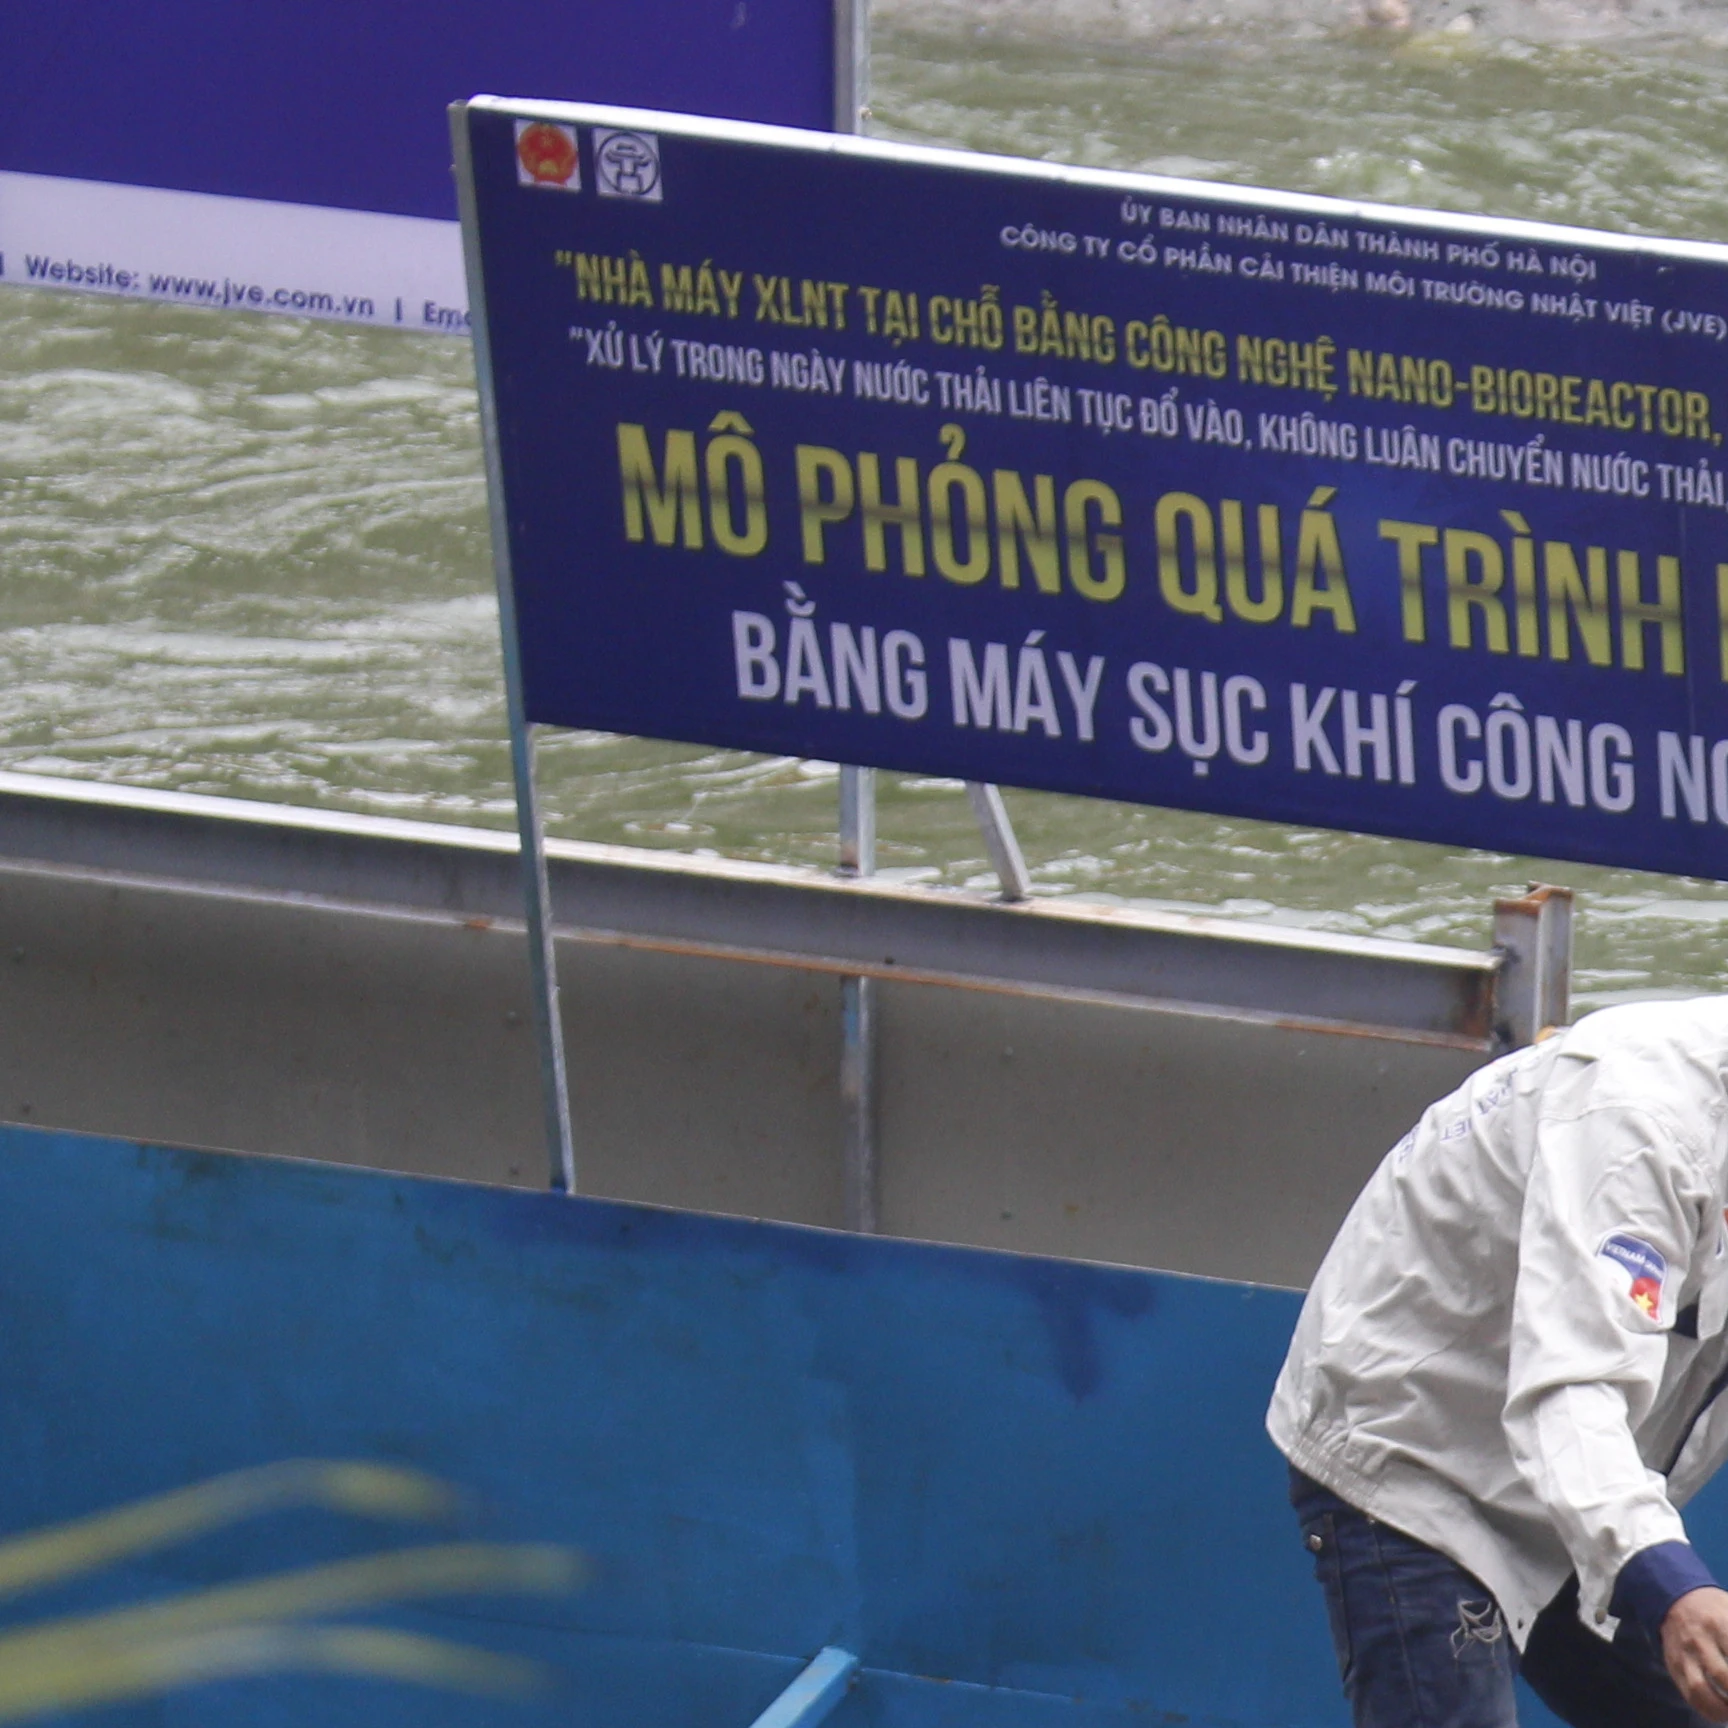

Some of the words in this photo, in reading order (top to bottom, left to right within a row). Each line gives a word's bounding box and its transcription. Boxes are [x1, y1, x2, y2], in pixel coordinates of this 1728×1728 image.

[25, 253, 140, 290] Website:
[149, 270, 375, 318] www.jve.com.vn
[1001, 222, 1078, 255] CÔNG
[1083, 235, 1111, 258] TY
[1163, 241, 1233, 275] PHẦN
[1239, 252, 1284, 281] CẢI
[1290, 262, 1359, 295] THIỆN
[1365, 271, 1415, 298] MÔI
[1531, 293, 1598, 324] NHẬT
[1604, 300, 1654, 329] VIỆT
[1661, 310, 1728, 340] (JVE)
[1159, 206, 1211, 232] BAN
[1217, 213, 1289, 243] NHÂN
[1295, 221, 1350, 249] DÂN
[1355, 231, 1440, 262] THÀNH
[1446, 241, 1500, 269] PHỐ
[1506, 249, 1543, 275] HÀ
[1549, 255, 1597, 285] NỘI
[630, 329, 665, 374] LÝ
[672, 339, 765, 388] TRONG
[771, 348, 847, 397] NGÀY
[853, 356, 931, 407] NƯỚC
[935, 364, 1002, 414] THẢI
[1008, 375, 1072, 425] LIÊN
[1076, 388, 1134, 437] TỤC
[1139, 386, 1180, 439] ĐỔ
[1185, 399, 1253, 450] VÀO,
[1258, 412, 1359, 463] KHÔNG
[1364, 424, 1442, 474] LUÂN
[1447, 433, 1565, 488] CHUYỂN
[1570, 450, 1650, 499] NƯỚC
[660, 258, 743, 319] MÁY
[752, 274, 850, 331] XLNT
[858, 286, 920, 348] TẠI
[928, 284, 1003, 353] CHỖ
[1013, 289, 1117, 365] BẰNG
[1125, 314, 1229, 380] CÔNG
[1236, 335, 1339, 401] NGHỆ
[1347, 347, 1724, 447] NANO-BIOREACTOR,
[614, 408, 770, 558] MÔ
[795, 421, 1127, 604] PHỎNG
[1153, 485, 1358, 636] QUÁ
[1378, 509, 1687, 678] TRÌNH
[731, 580, 930, 723] BẰNG
[948, 629, 1106, 744] MÁY
[1126, 659, 1271, 777] SỤC
[1289, 679, 1418, 789] KHÍ
[1437, 691, 1637, 814] CÔNG
